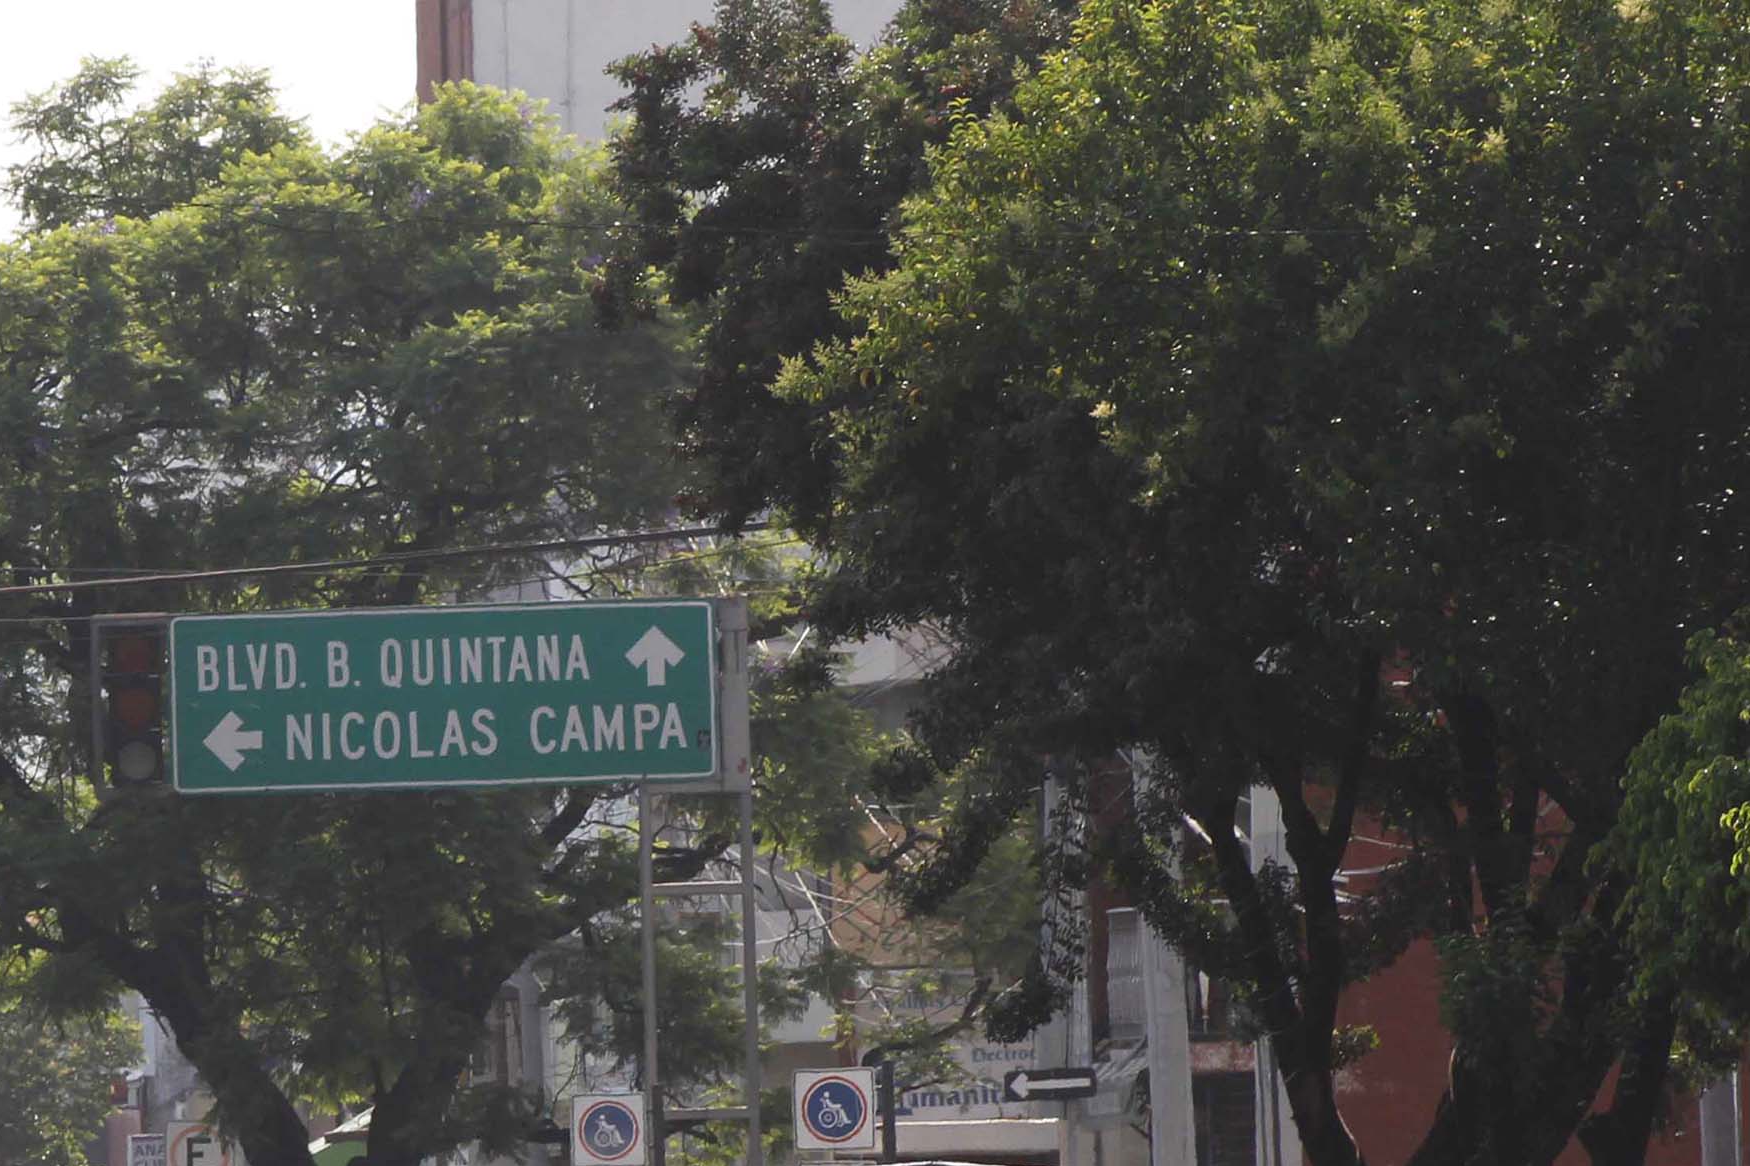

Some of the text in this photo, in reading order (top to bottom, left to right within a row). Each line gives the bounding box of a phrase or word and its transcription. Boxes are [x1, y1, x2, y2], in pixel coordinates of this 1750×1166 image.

[196, 634, 591, 692] BLVD. B. QUINTANA
[285, 702, 688, 761] NICOLAS CAMPA
